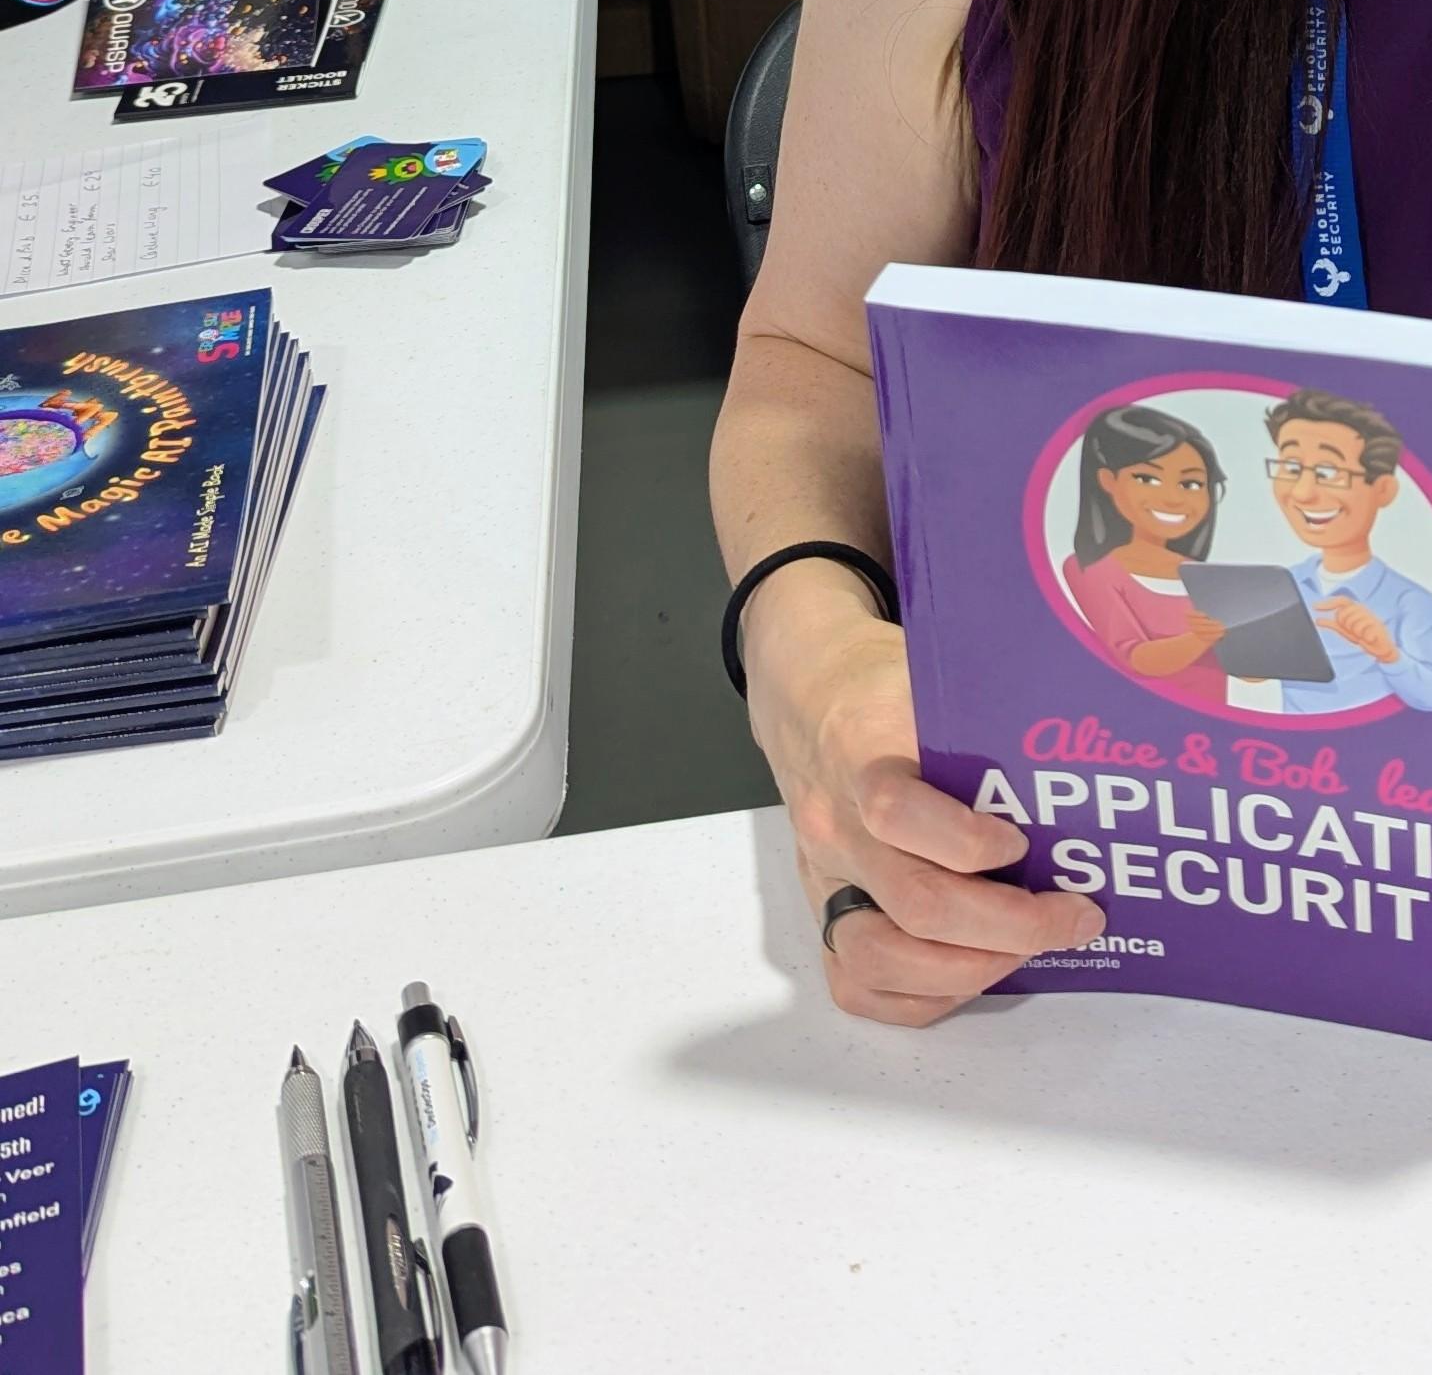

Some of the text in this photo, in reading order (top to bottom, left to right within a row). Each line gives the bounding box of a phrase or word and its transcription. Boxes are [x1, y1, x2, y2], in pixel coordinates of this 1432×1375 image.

[104, 12, 134, 73] OWASP
[275, 70, 348, 84] BOOKLET
[276, 78, 343, 91] STICKER
[1323, 171, 1343, 256] SECURITY
[36, 351, 197, 533] Magic AI Paintbrush
[1022, 715, 1168, 771] Alice
[1176, 733, 1219, 778] &
[1231, 737, 1350, 796] Bob
[1074, 935, 1166, 957] anca
[5, 1161, 56, 1185] Veer
